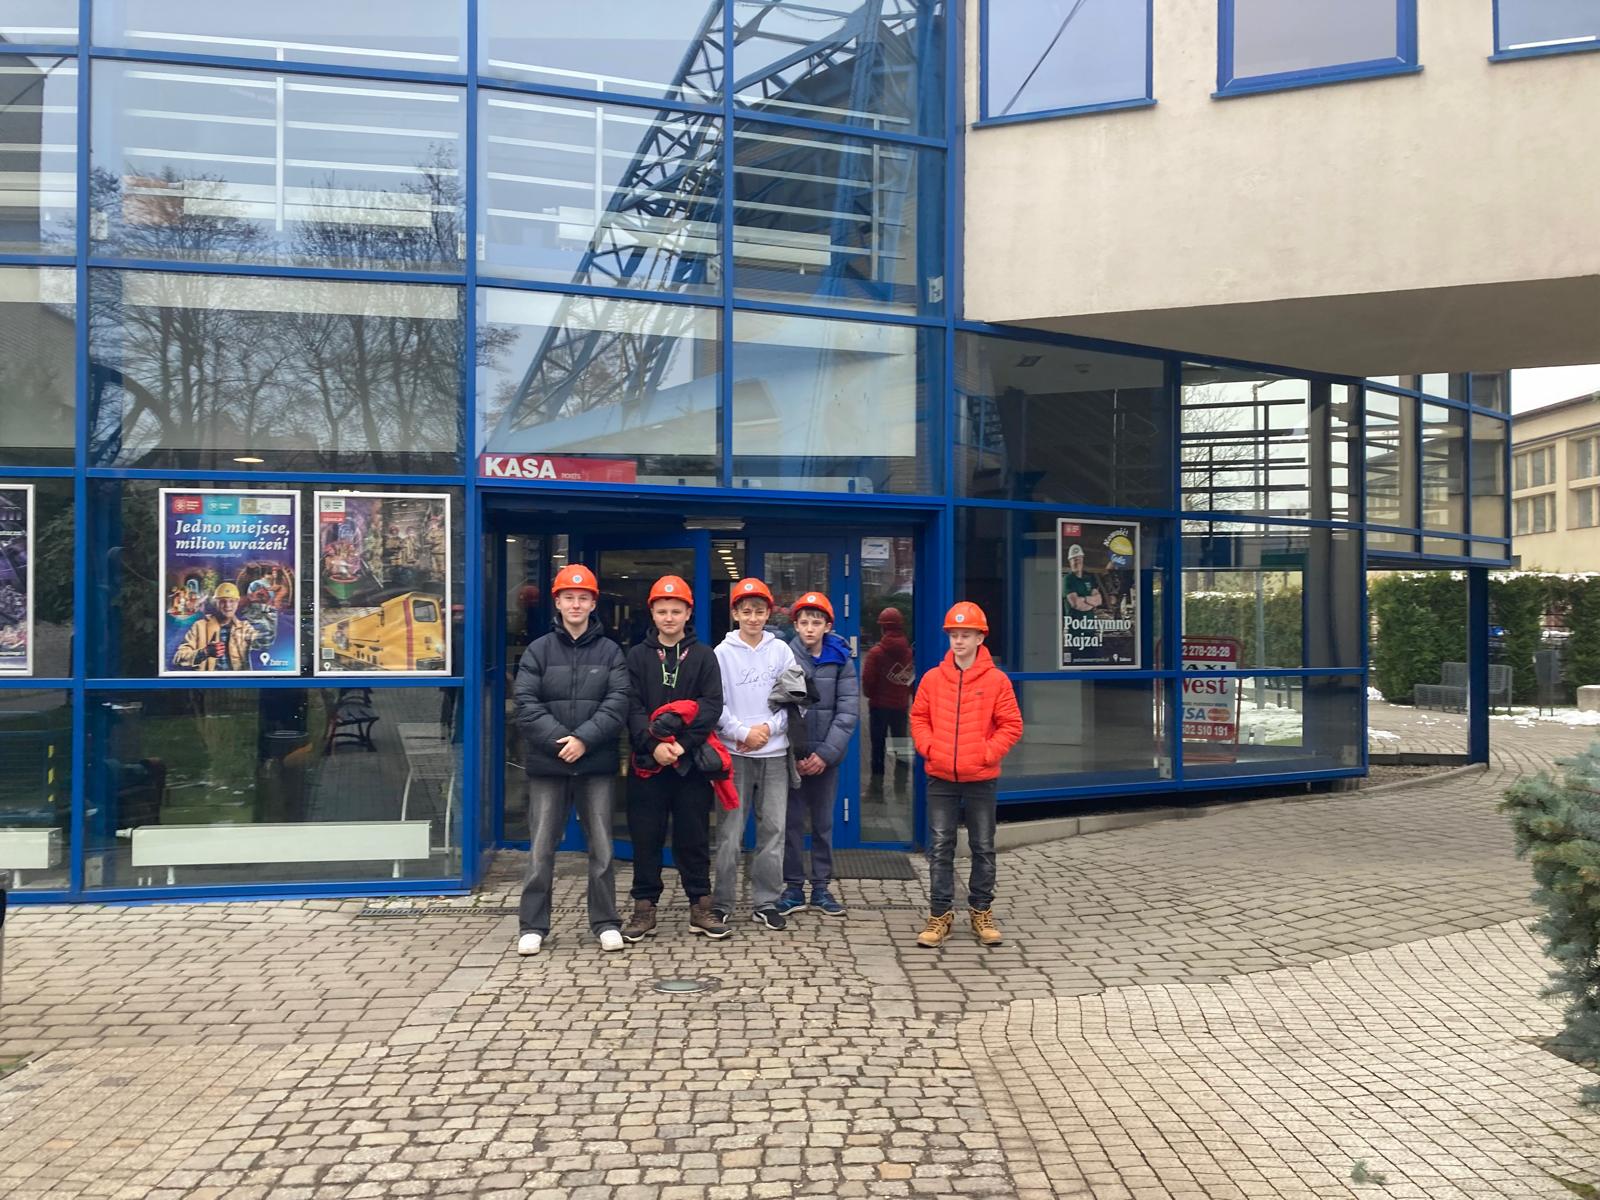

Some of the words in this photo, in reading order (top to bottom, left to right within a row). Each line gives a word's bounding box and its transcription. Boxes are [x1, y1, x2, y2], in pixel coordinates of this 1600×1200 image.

[485, 456, 556, 479] KASA
[174, 519, 222, 535] Jedno
[226, 520, 290, 537] miejsce,
[175, 536, 225, 550] milion
[228, 538, 289, 551] wrażeń!
[1064, 633, 1103, 651] Rajza!
[1182, 663, 1227, 671] AXI
[1182, 707, 1206, 720] SA
